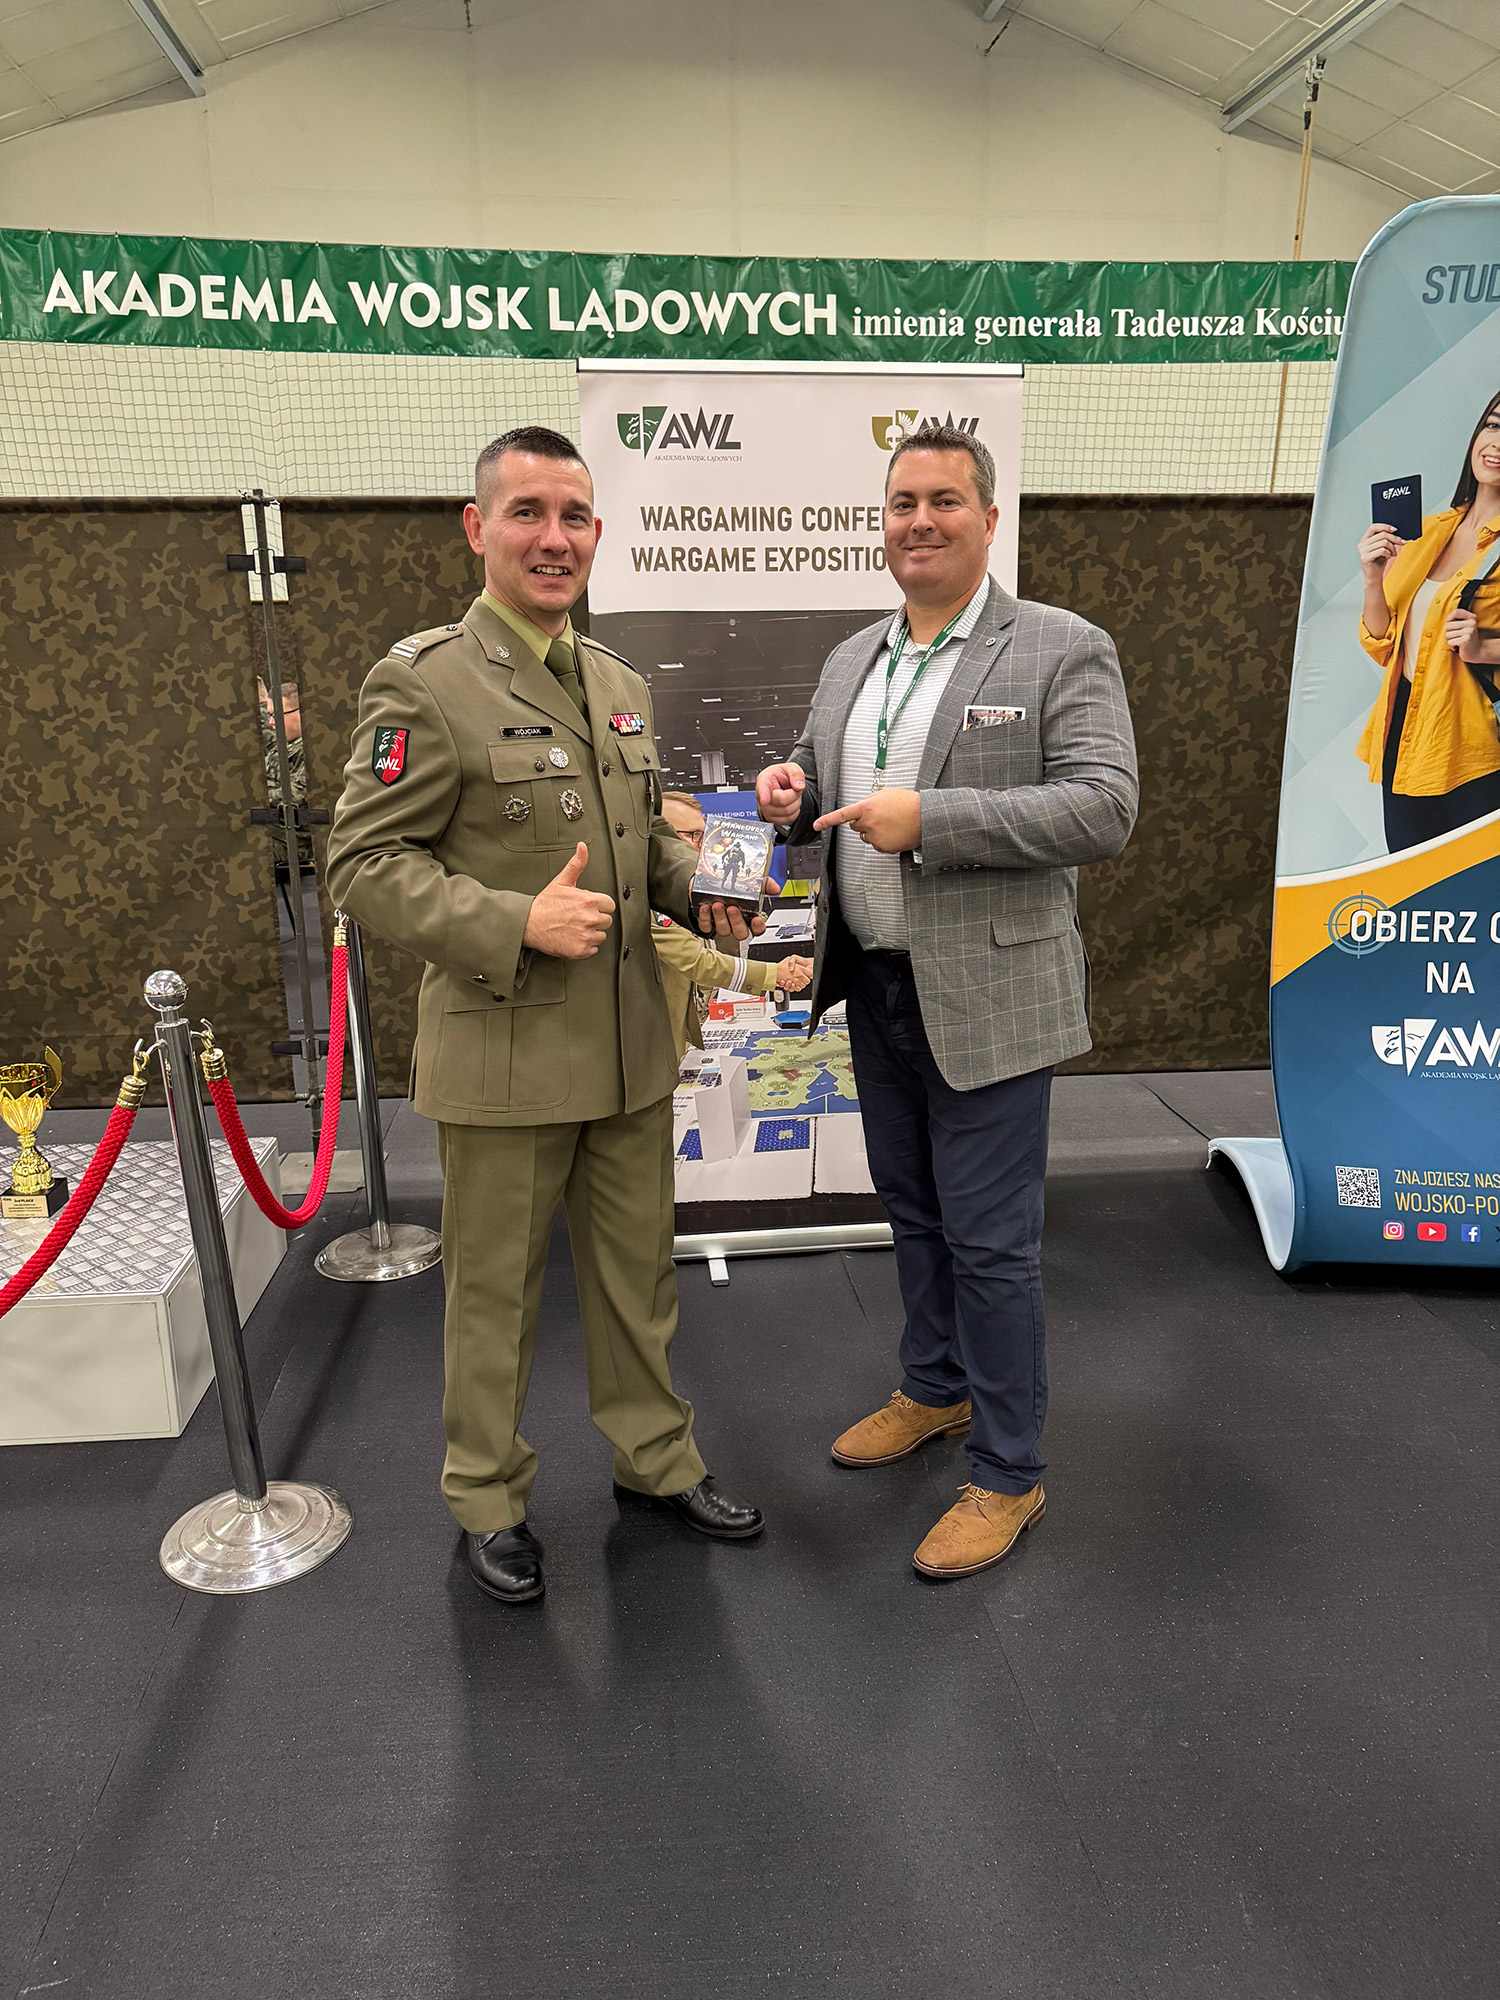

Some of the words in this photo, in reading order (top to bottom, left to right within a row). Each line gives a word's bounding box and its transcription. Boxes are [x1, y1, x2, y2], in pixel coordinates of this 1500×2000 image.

[42, 267, 338, 325] AKADEMIA
[347, 280, 533, 330] WOJSK
[548, 287, 837, 339] LĄDOWYCH
[852, 307, 965, 338] imienia
[974, 308, 1101, 345] generała
[1111, 308, 1245, 337] Tadeusza
[658, 406, 741, 449] AWL
[1392, 486, 1411, 498] AWL
[640, 506, 792, 532] WARGAMING
[802, 506, 885, 532] CONFE
[631, 547, 755, 572] WARGAME
[764, 546, 887, 572] EXPOSITIO
[375, 756, 400, 770] AWL
[1351, 910, 1477, 943] OBIERZ
[1426, 962, 1475, 994] NA
[1424, 1020, 1500, 1067] AW
[1394, 1169, 1471, 1188] ZNAJDZIESZ
[1474, 1173, 1500, 1189] NAS
[1395, 1191, 1500, 1215] WOJSKO-PO
